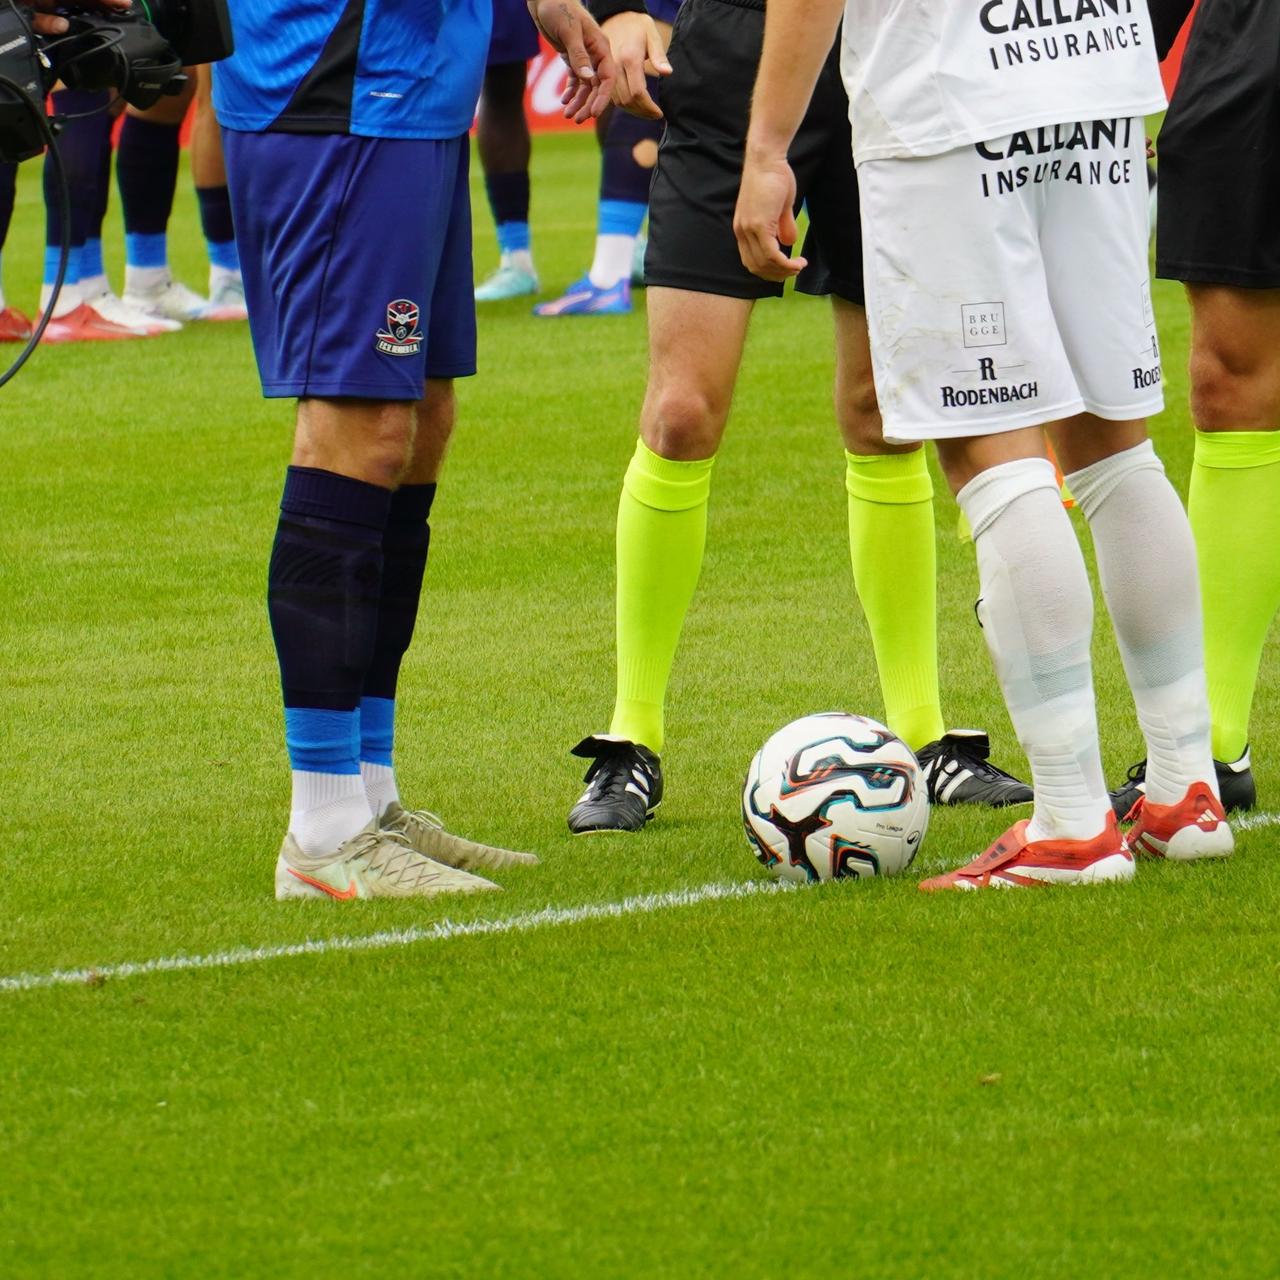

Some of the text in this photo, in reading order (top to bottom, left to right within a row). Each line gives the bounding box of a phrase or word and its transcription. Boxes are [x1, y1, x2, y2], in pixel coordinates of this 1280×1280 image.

[989, 23, 1141, 70] INSURANCE
[981, 159, 1131, 197] INSURANCE
[969, 313, 999, 324] BRU
[969, 325, 1000, 336] GGE
[886, 824, 903, 832] League
